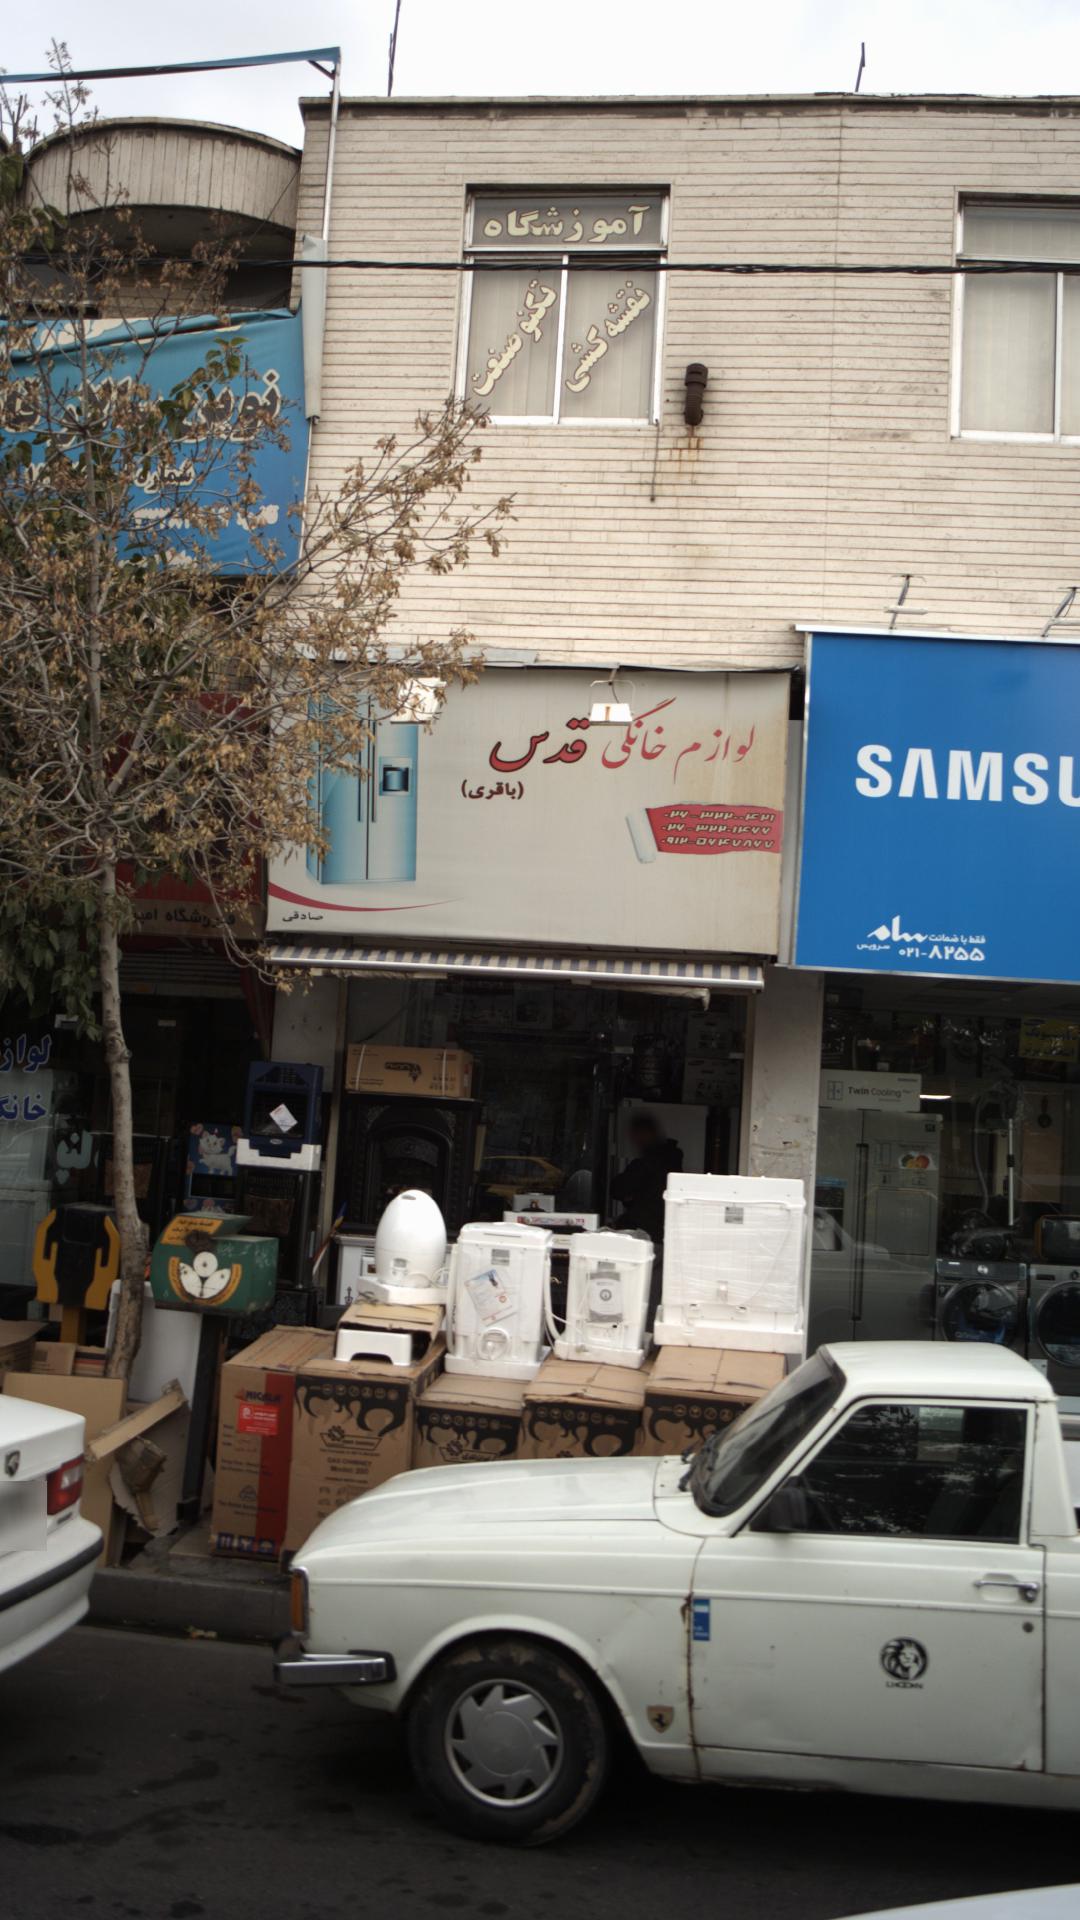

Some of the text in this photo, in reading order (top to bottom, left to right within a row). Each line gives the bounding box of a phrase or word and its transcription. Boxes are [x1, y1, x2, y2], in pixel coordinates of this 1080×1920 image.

[483, 205, 650, 243] آموزشگاه
[565, 280, 651, 393] نقشه کشی
[472, 332, 523, 396] صنعت
[489, 696, 756, 785] لوازم خانگی قدس
[282, 911, 324, 922] صادقی
[0, 1033, 53, 1073] لواز
[848, 1086, 870, 1096] Twin
[870, 1088, 902, 1099] Cooling
